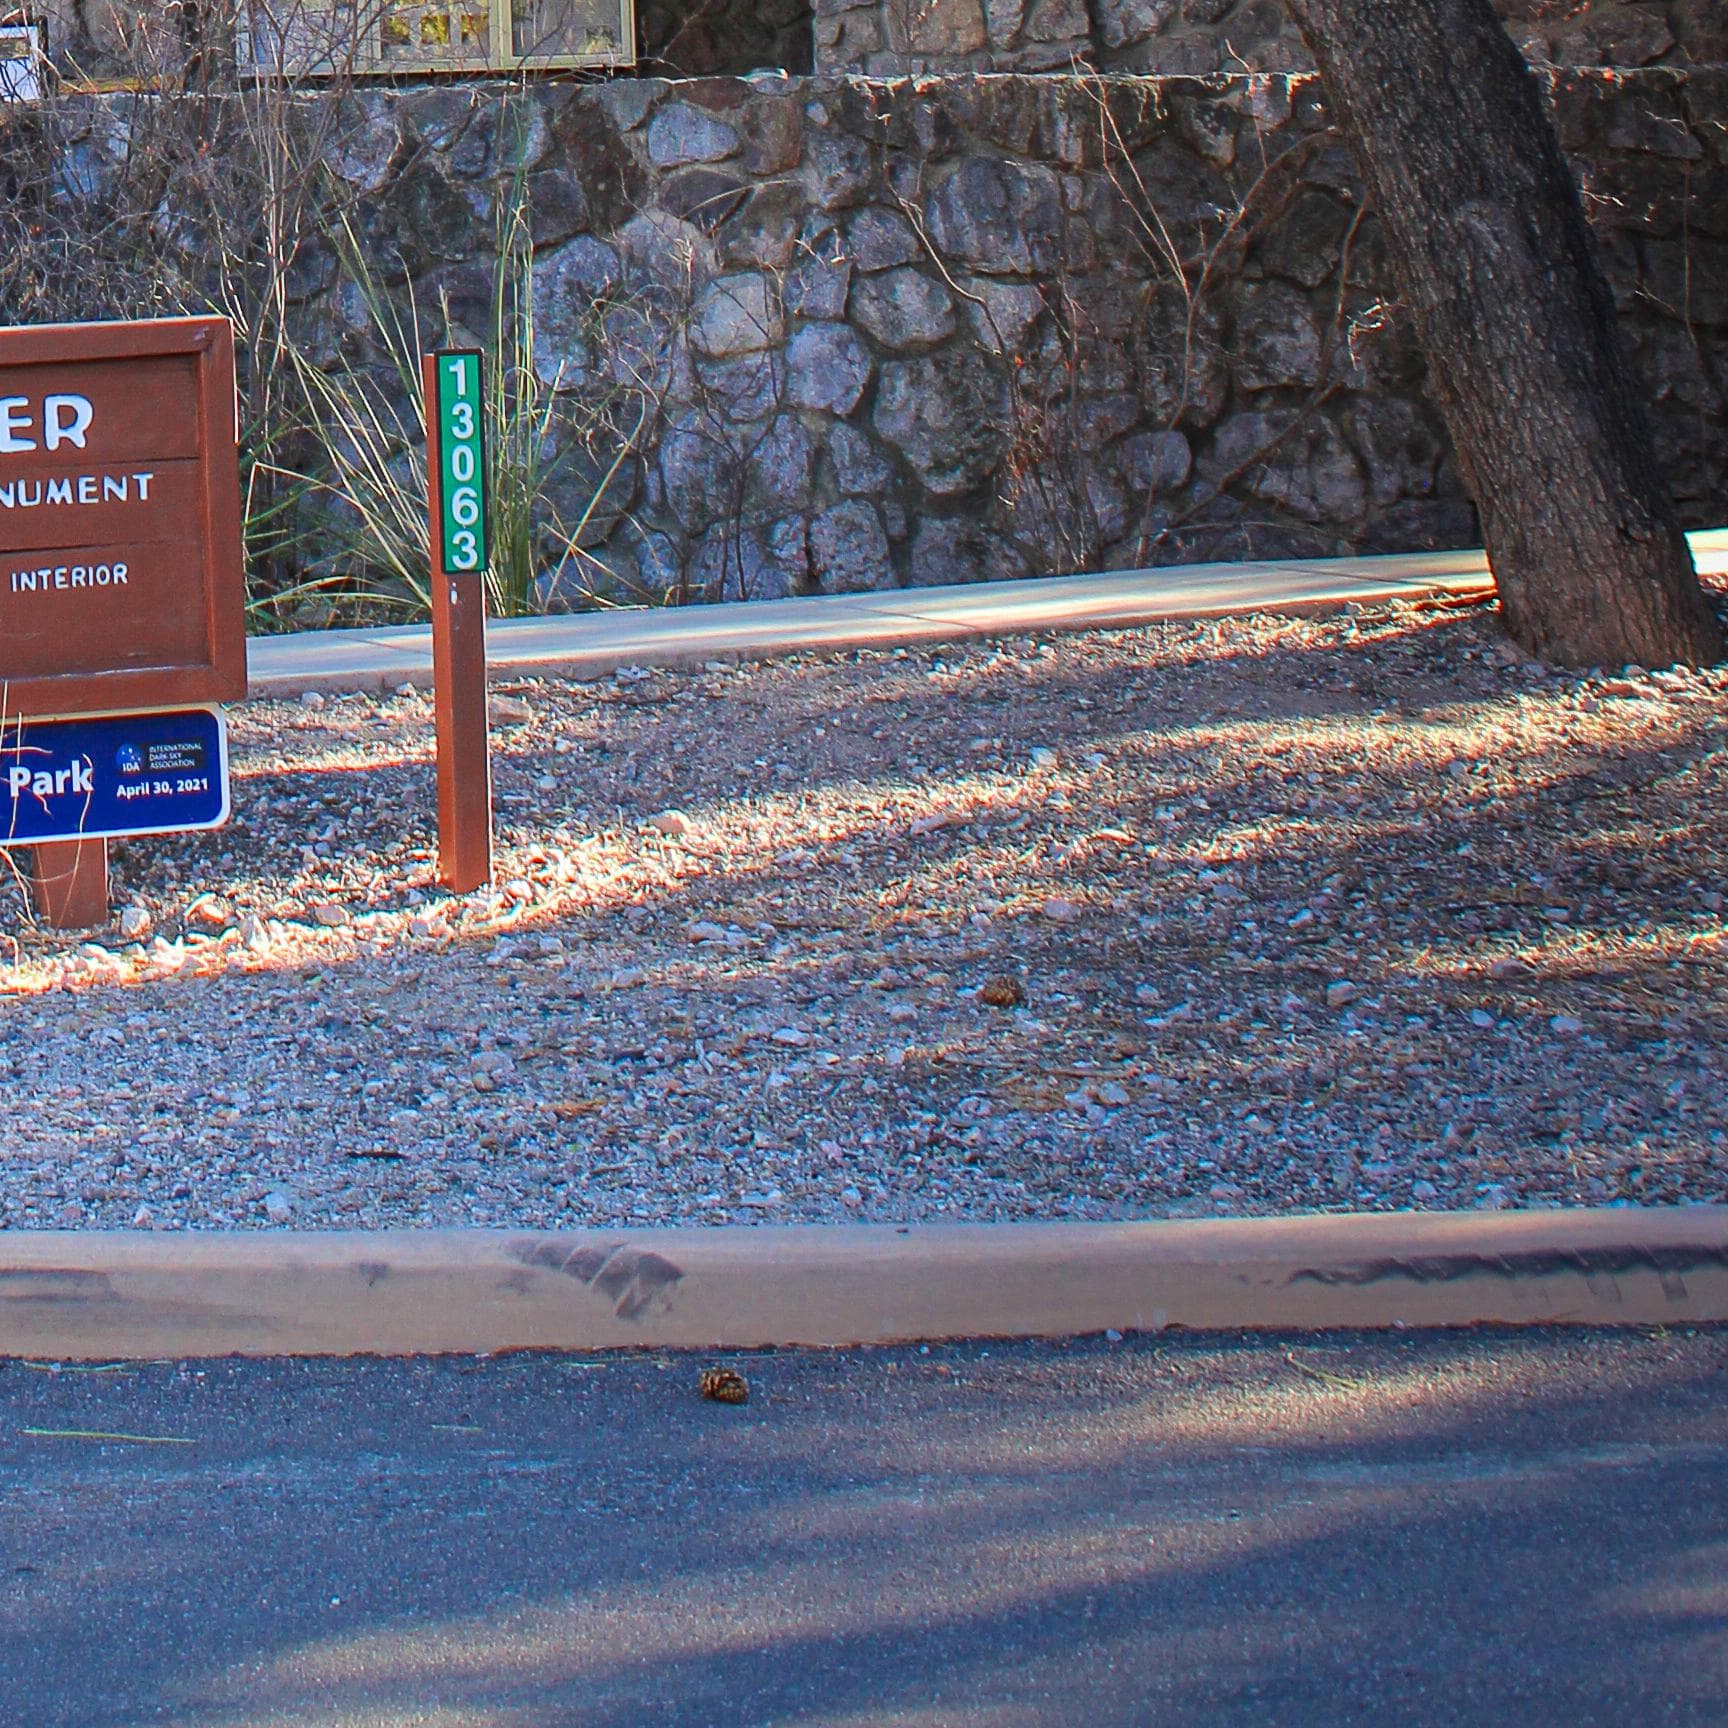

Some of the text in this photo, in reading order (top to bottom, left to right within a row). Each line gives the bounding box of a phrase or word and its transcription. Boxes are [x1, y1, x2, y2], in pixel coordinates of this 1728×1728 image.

[448, 358, 479, 571] 13063
[11, 562, 129, 593] INTERIOR
[149, 743, 202, 753] INTERNATIONAL
[149, 752, 182, 761] DARK SKY
[150, 759, 195, 769] ASSOCIATION
[122, 762, 141, 772] IDA
[8, 759, 93, 798] Park
[116, 777, 208, 800] April 30, 2021
